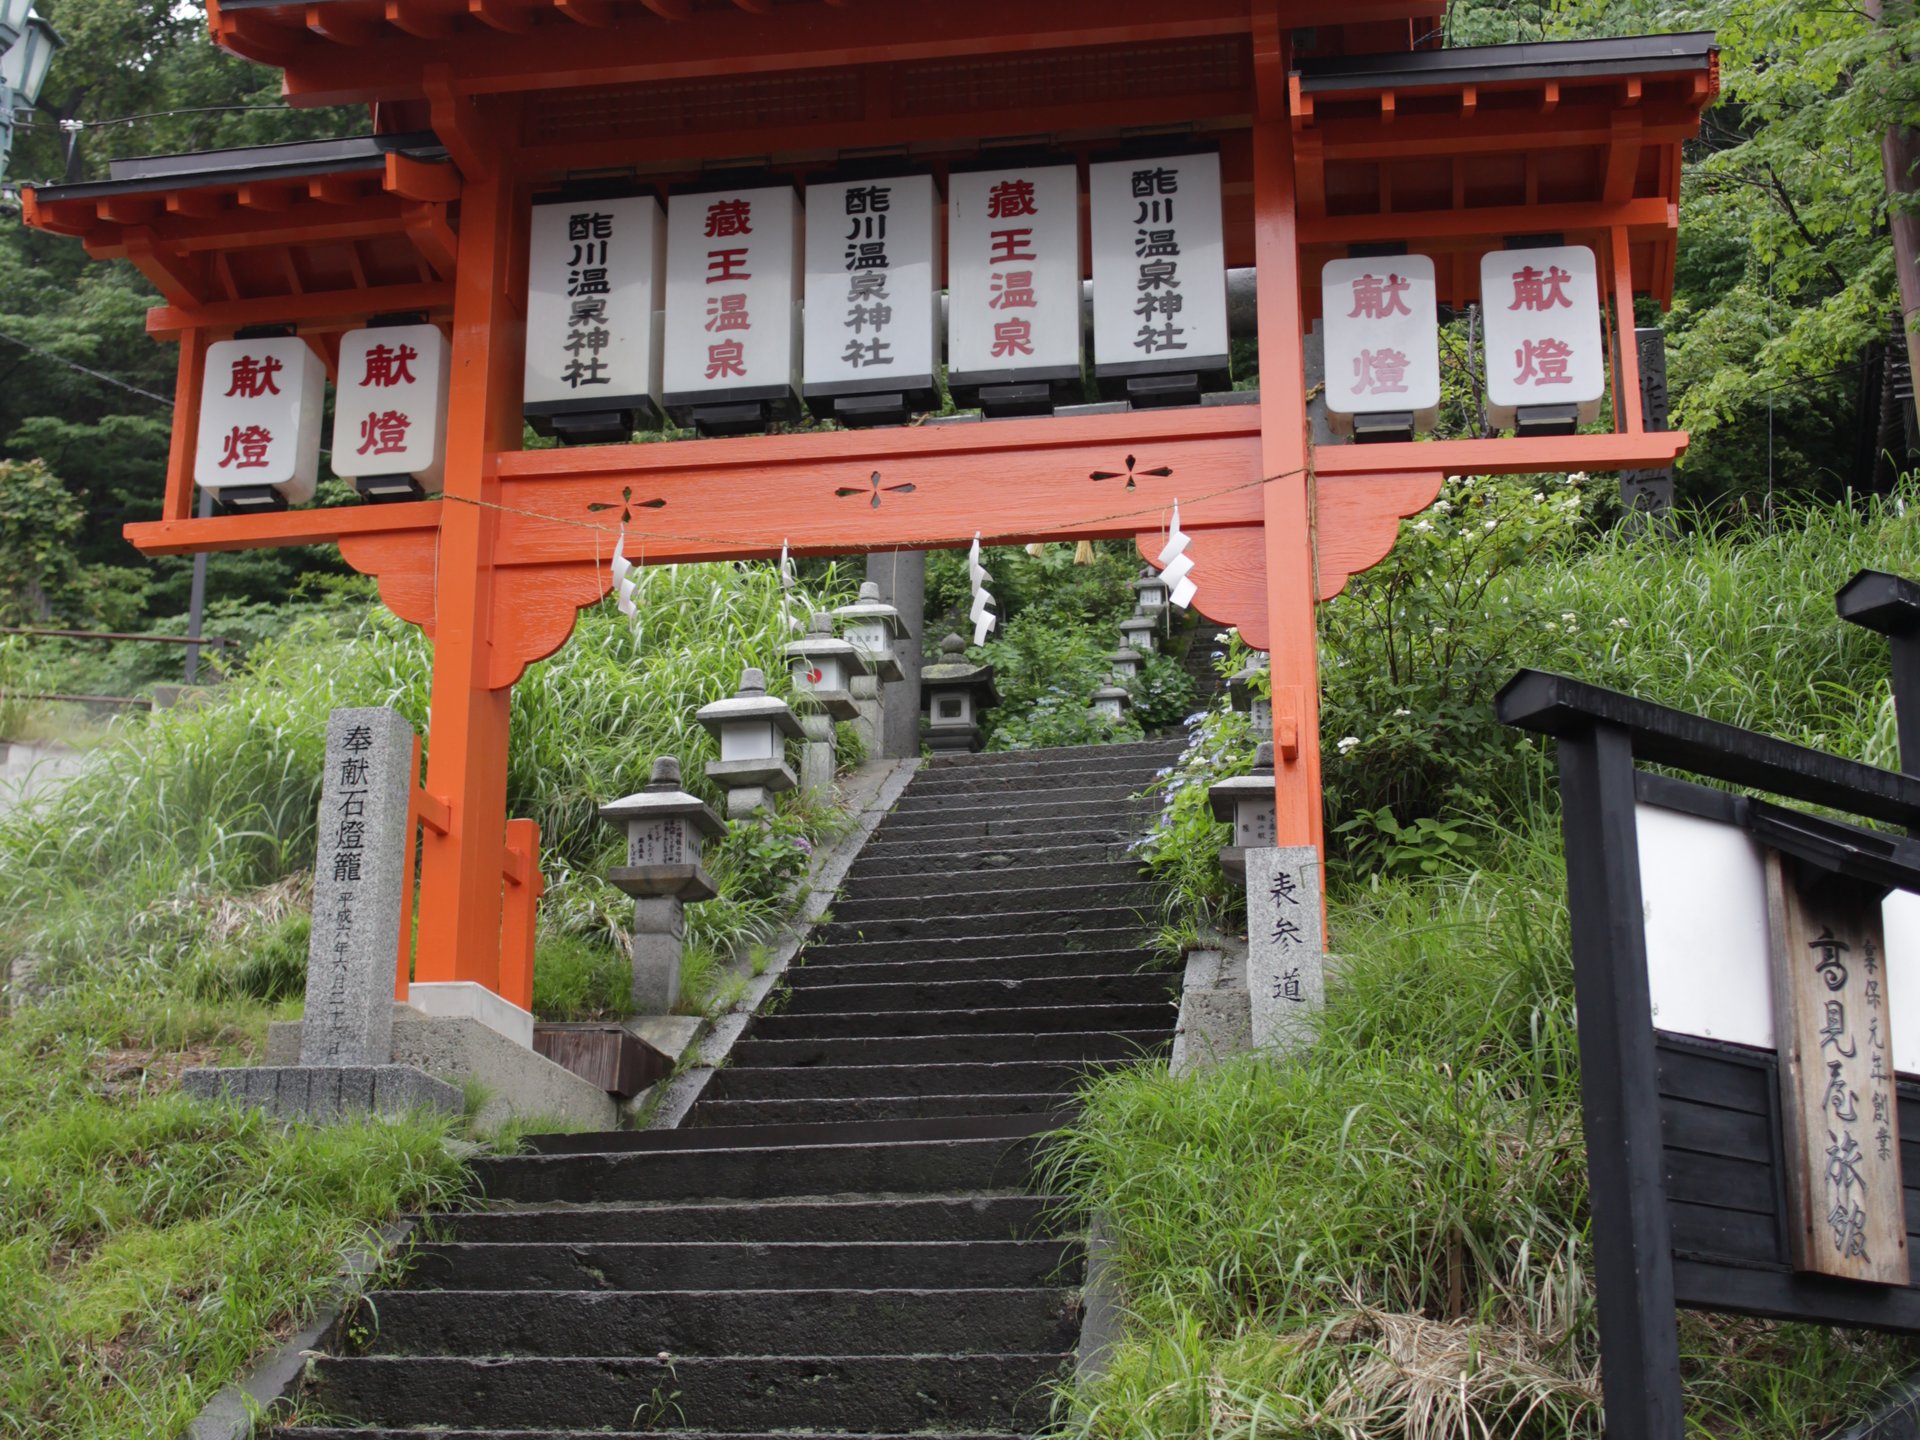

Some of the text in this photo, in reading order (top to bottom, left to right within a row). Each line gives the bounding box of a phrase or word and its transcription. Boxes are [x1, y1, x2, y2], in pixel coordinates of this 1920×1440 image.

[561, 212, 613, 389] 酢川温泉神社
[705, 200, 752, 380] 蔵王温泉
[842, 186, 894, 368] 酢川温泉神社
[987, 180, 1039, 357] 蔵王温泉
[1131, 168, 1188, 354] 酢川温泉神社
[1348, 272, 1412, 395] 献燈
[1508, 266, 1573, 386] 献燈
[219, 355, 282, 470] 献燈
[358, 343, 417, 457] 献燈
[334, 725, 373, 882] 奉献石燈籠
[1269, 871, 1305, 1003] 表参道
